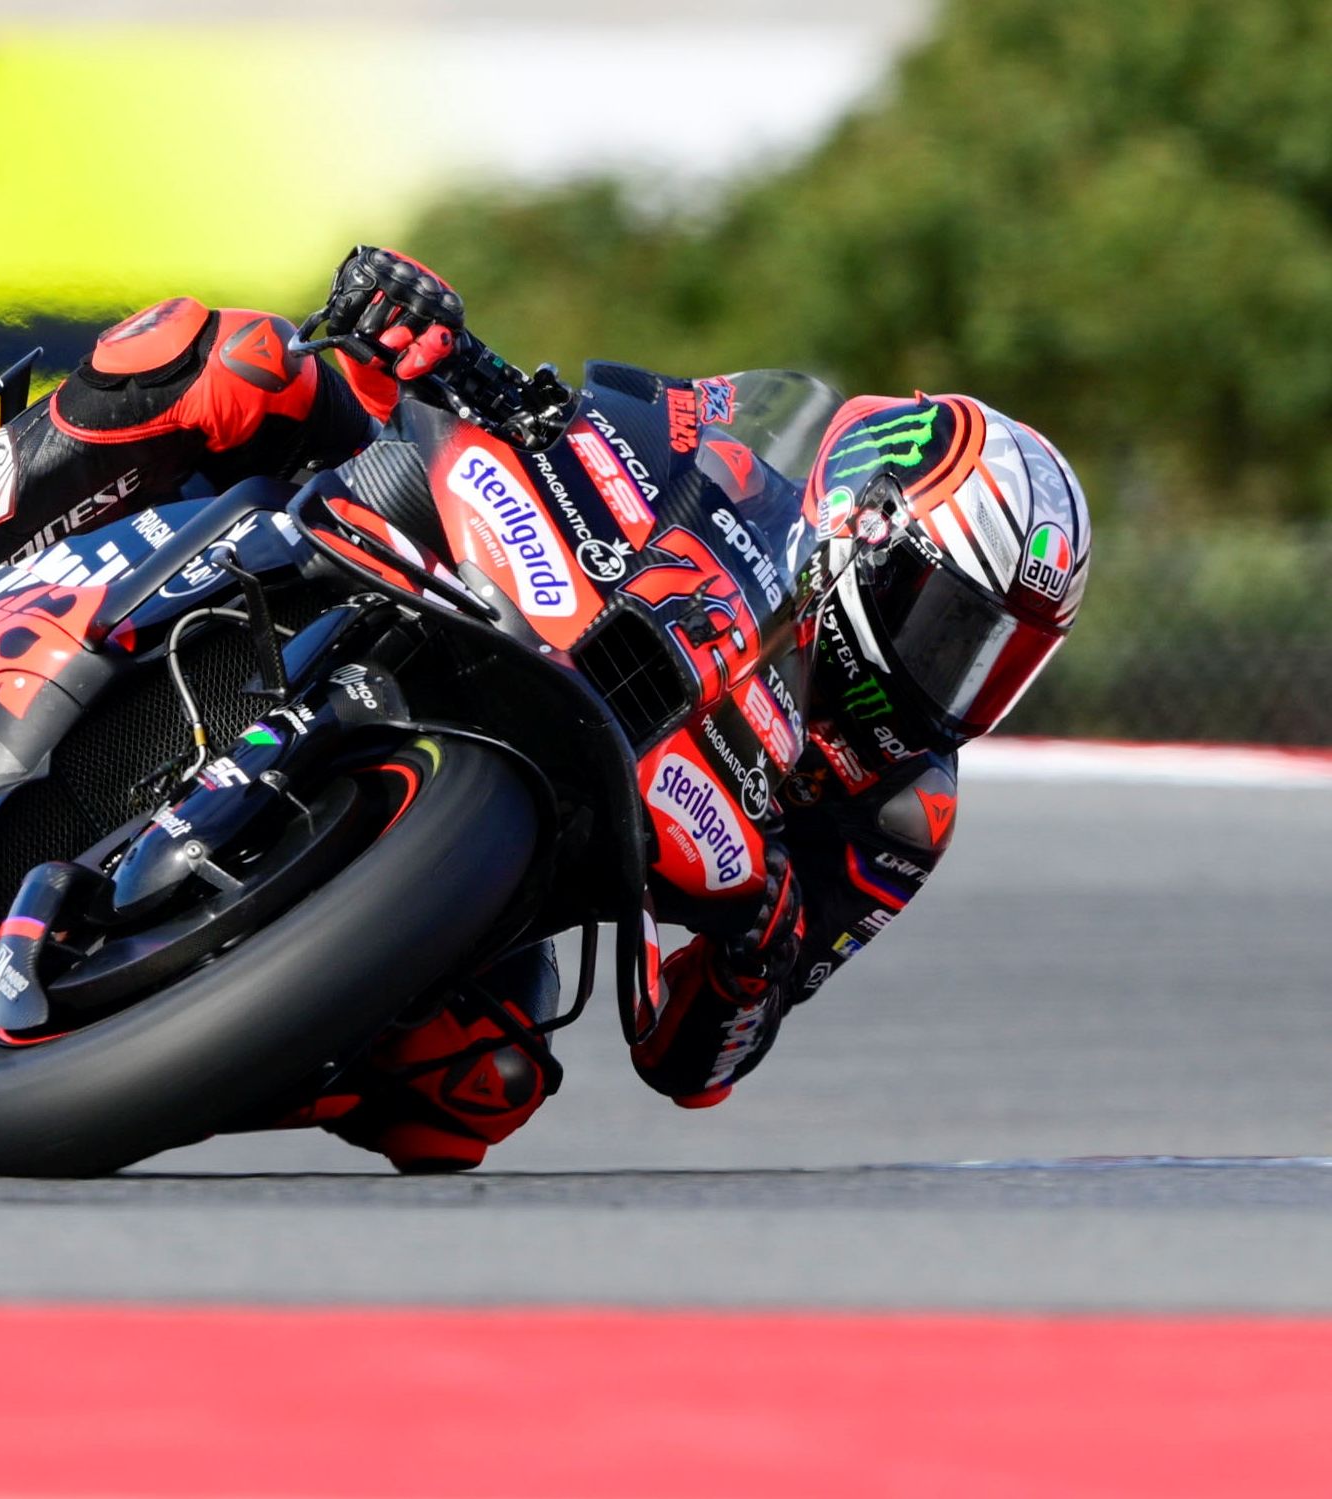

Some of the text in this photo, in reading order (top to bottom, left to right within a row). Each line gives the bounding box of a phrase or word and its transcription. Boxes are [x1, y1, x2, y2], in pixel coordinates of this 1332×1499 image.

[571, 432, 648, 523] BS
[586, 409, 659, 501] TARGA
[459, 456, 561, 607] sterilgarda
[469, 516, 509, 568] alimenti
[533, 452, 619, 580] PRAGMATIC PLAY
[712, 508, 783, 613] aprilia
[1026, 559, 1064, 592] agv
[701, 713, 768, 809] PRAGMATIC PLAY
[746, 681, 793, 763] BS
[206, 757, 250, 787] SC
[657, 764, 744, 882] sterilgarda
[667, 823, 698, 864] alimenti
